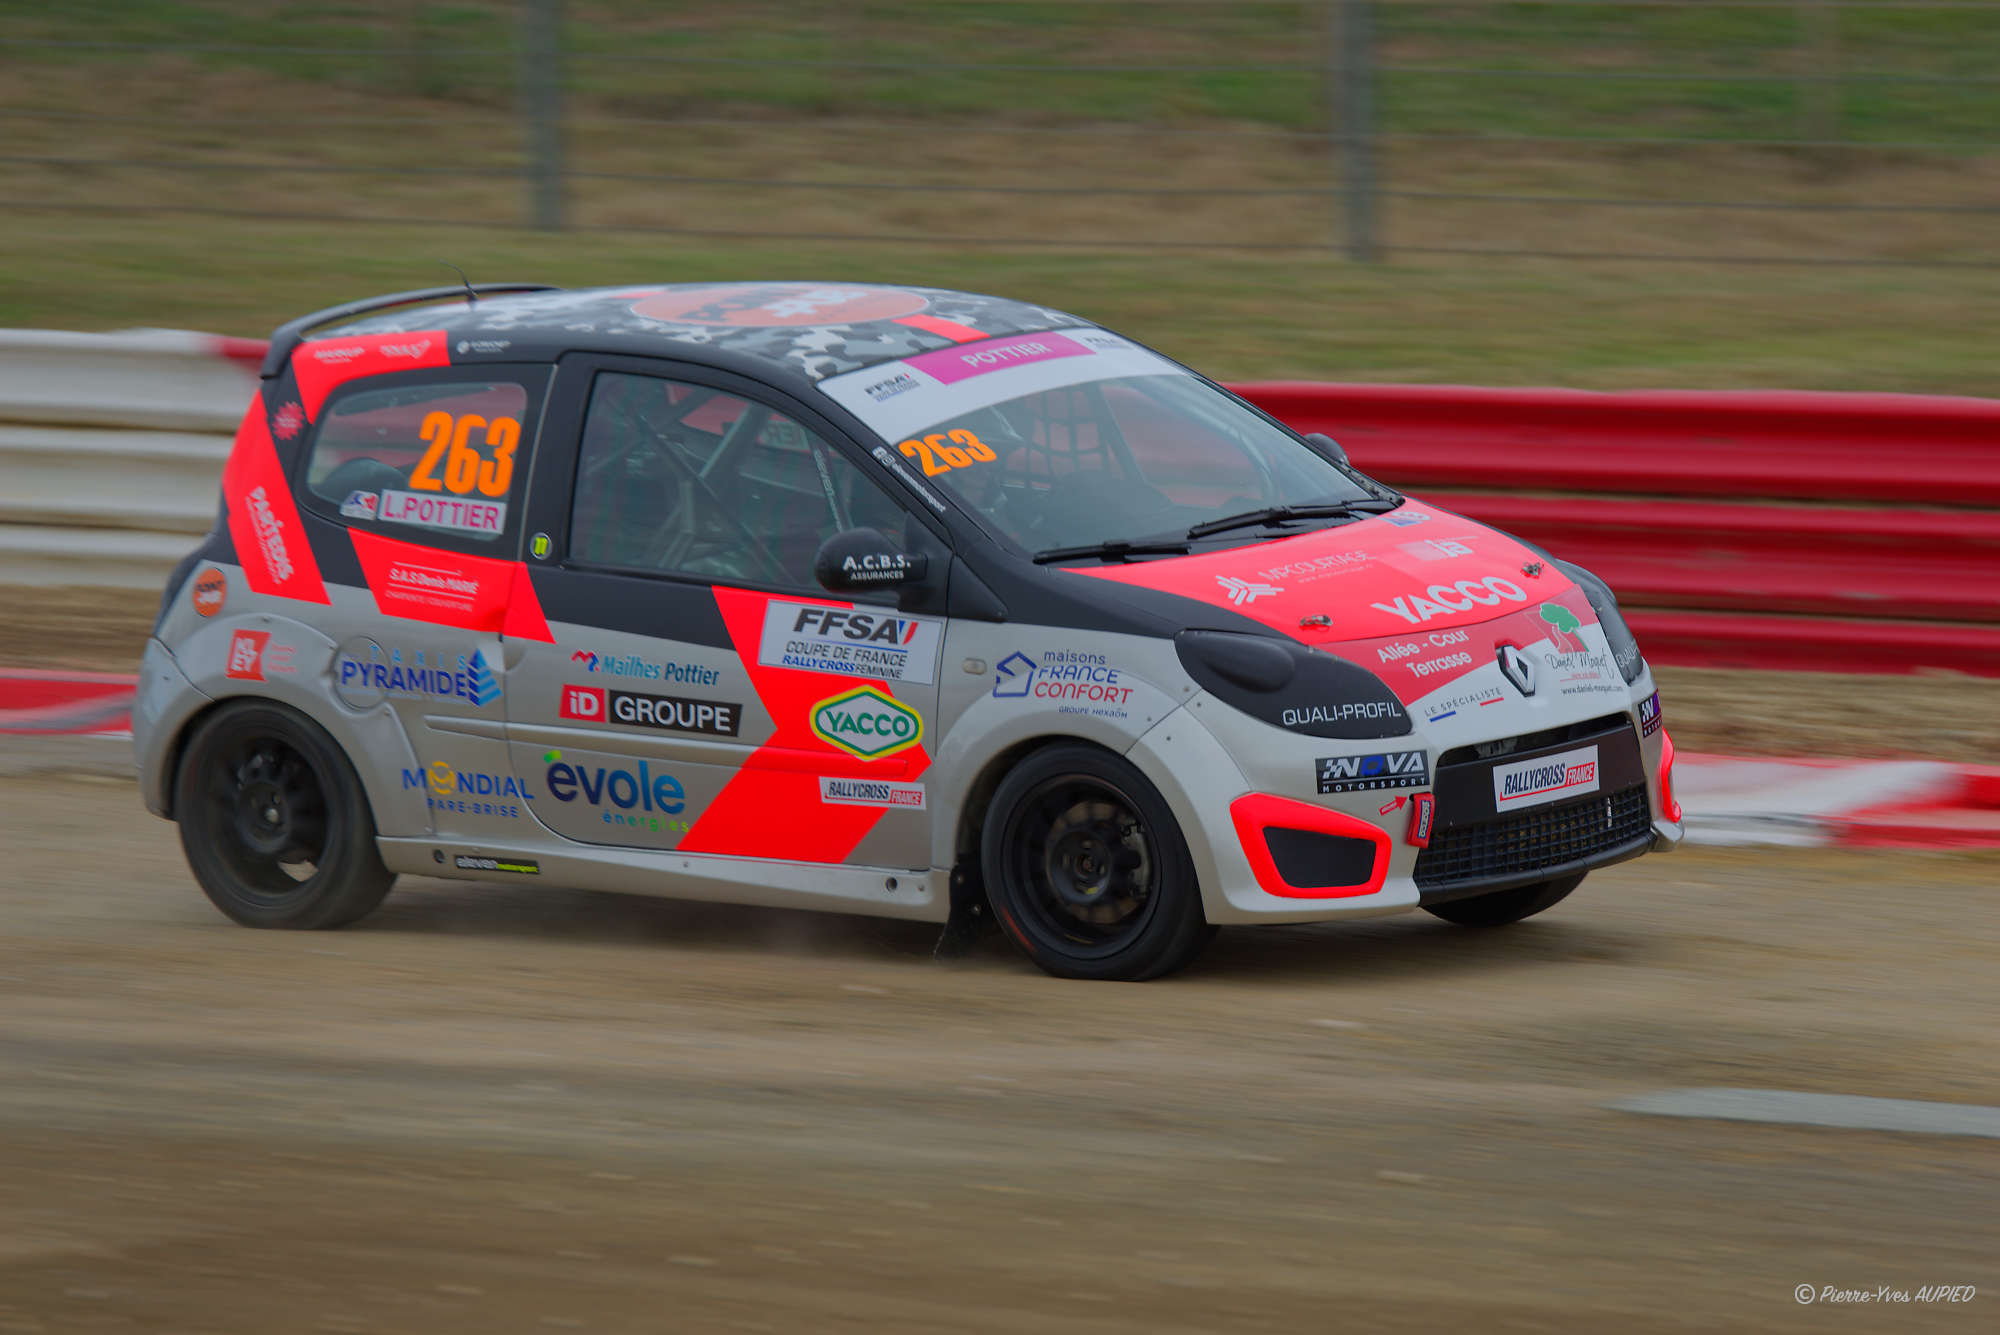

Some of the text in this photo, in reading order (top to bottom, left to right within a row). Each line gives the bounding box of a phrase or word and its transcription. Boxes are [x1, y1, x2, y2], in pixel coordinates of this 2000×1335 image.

[960, 342, 1053, 369] POTTIER
[863, 374, 906, 395] FFSA
[408, 411, 521, 497] 263
[898, 428, 998, 478] 263
[384, 495, 500, 530] L.POTTIER
[842, 555, 912, 571] A.C.B.S.
[850, 570, 905, 581] ASSURANCES
[1369, 576, 1528, 625] YACCO
[793, 608, 904, 645] FFSA
[785, 640, 908, 668] COUPE DE FRANCE
[1043, 648, 1106, 665] maisons
[1377, 642, 1421, 664] Allée
[1429, 629, 1470, 648] Cour
[601, 653, 720, 687] Mailhes Pottier
[782, 654, 856, 674] RALLYCROSS
[1038, 665, 1121, 684] FRANCE
[1406, 651, 1473, 679] Terrasse
[341, 660, 468, 697] PYRAMIDE
[1034, 681, 1134, 705] CONFORT
[568, 690, 733, 733] iD GROUPE
[824, 710, 911, 737] YACCO
[1281, 701, 1402, 726] QUALI-PROFIL
[402, 760, 536, 801] MONDIAL
[1322, 777, 1426, 793] MOTORSPORT
[1503, 762, 1595, 796] RALLYCROSS FRANCE
[827, 780, 923, 806] RALLYCROSS FRANCE
[427, 797, 520, 819] PARE-BRISE
[602, 810, 690, 834] énergies
